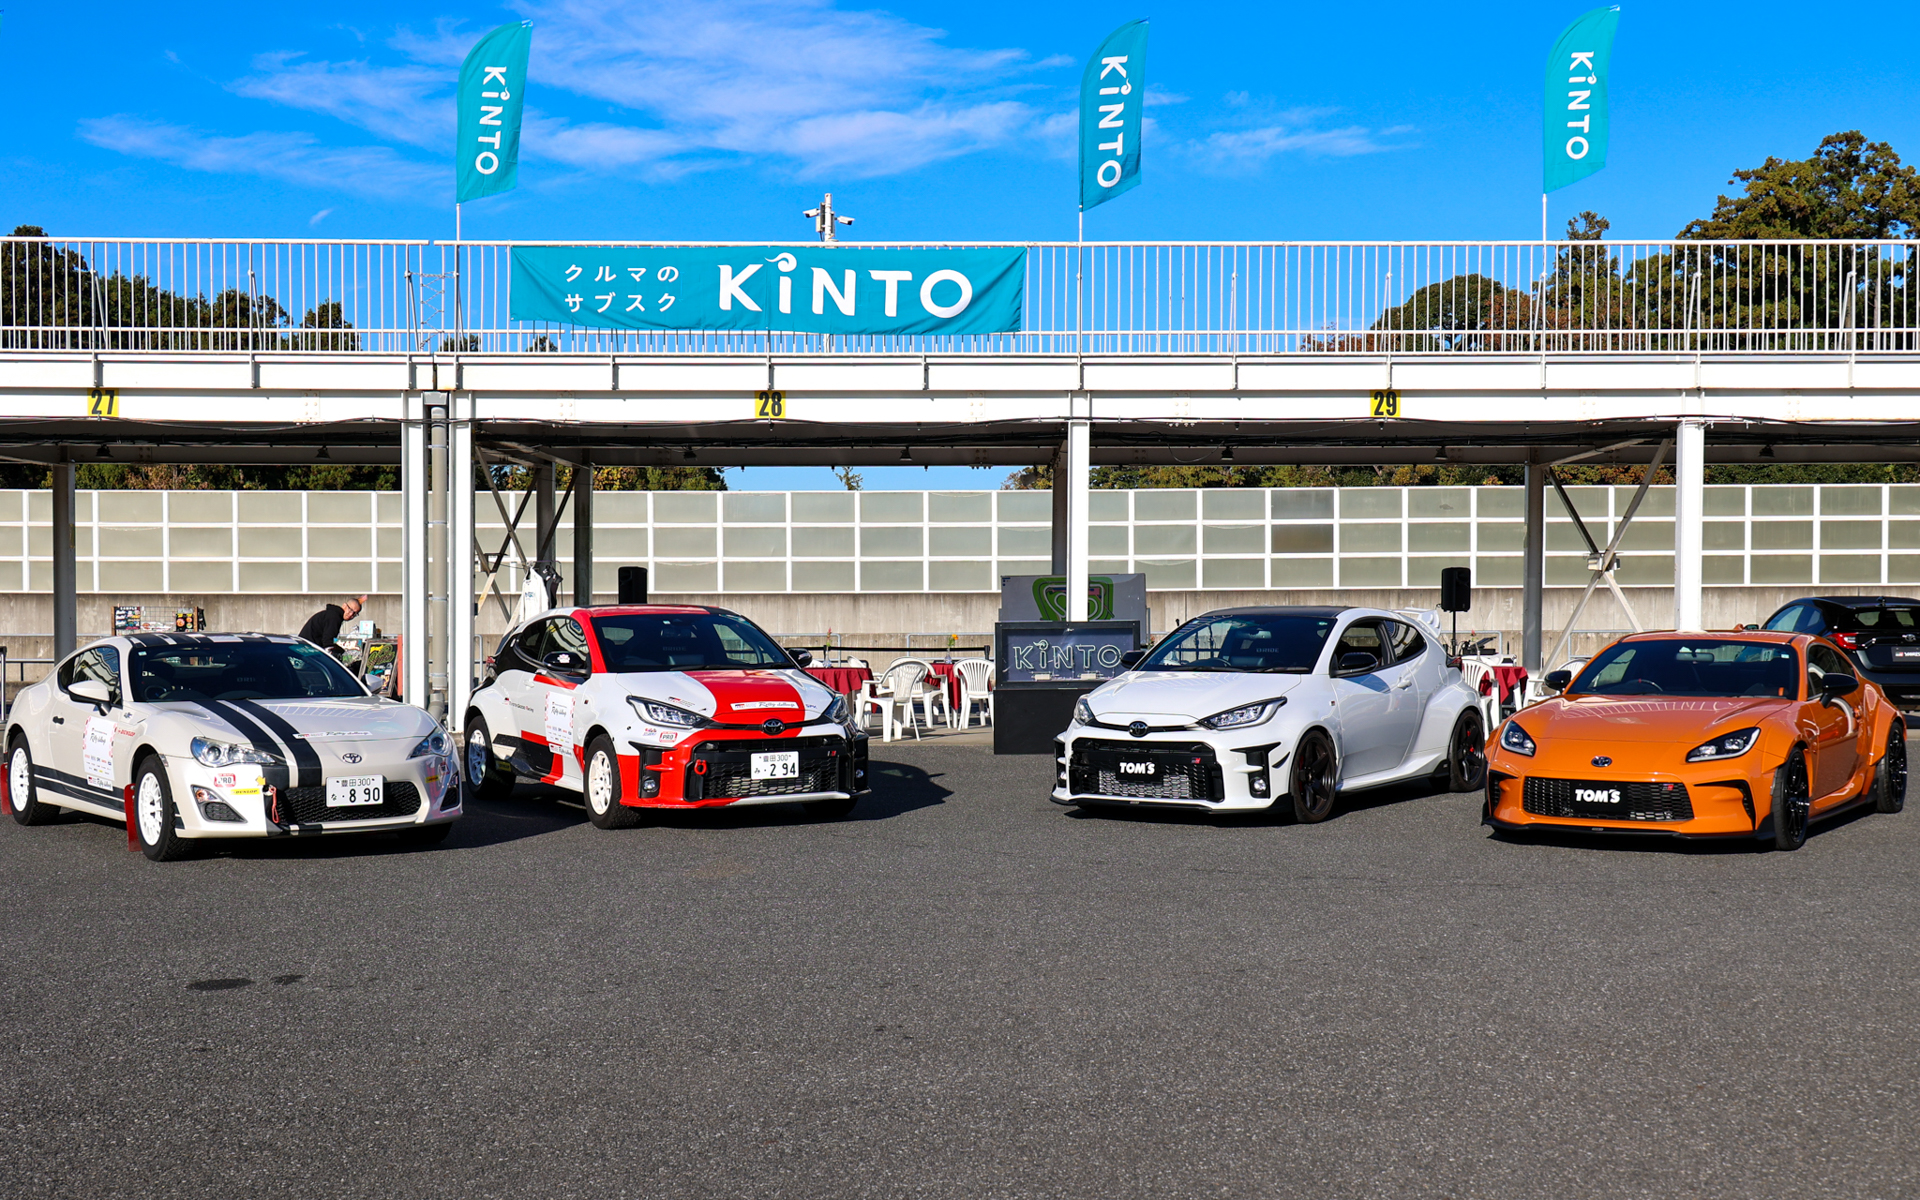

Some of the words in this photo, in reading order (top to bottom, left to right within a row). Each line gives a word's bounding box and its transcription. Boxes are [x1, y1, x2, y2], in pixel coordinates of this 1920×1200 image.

[564, 264, 680, 283] クルマの
[564, 292, 677, 314] サブスク
[91, 390, 115, 415] 27
[759, 391, 783, 417] 28
[1373, 391, 1398, 416] 29
[1119, 761, 1156, 775] TOM'S
[1574, 788, 1621, 804] TOM'S
